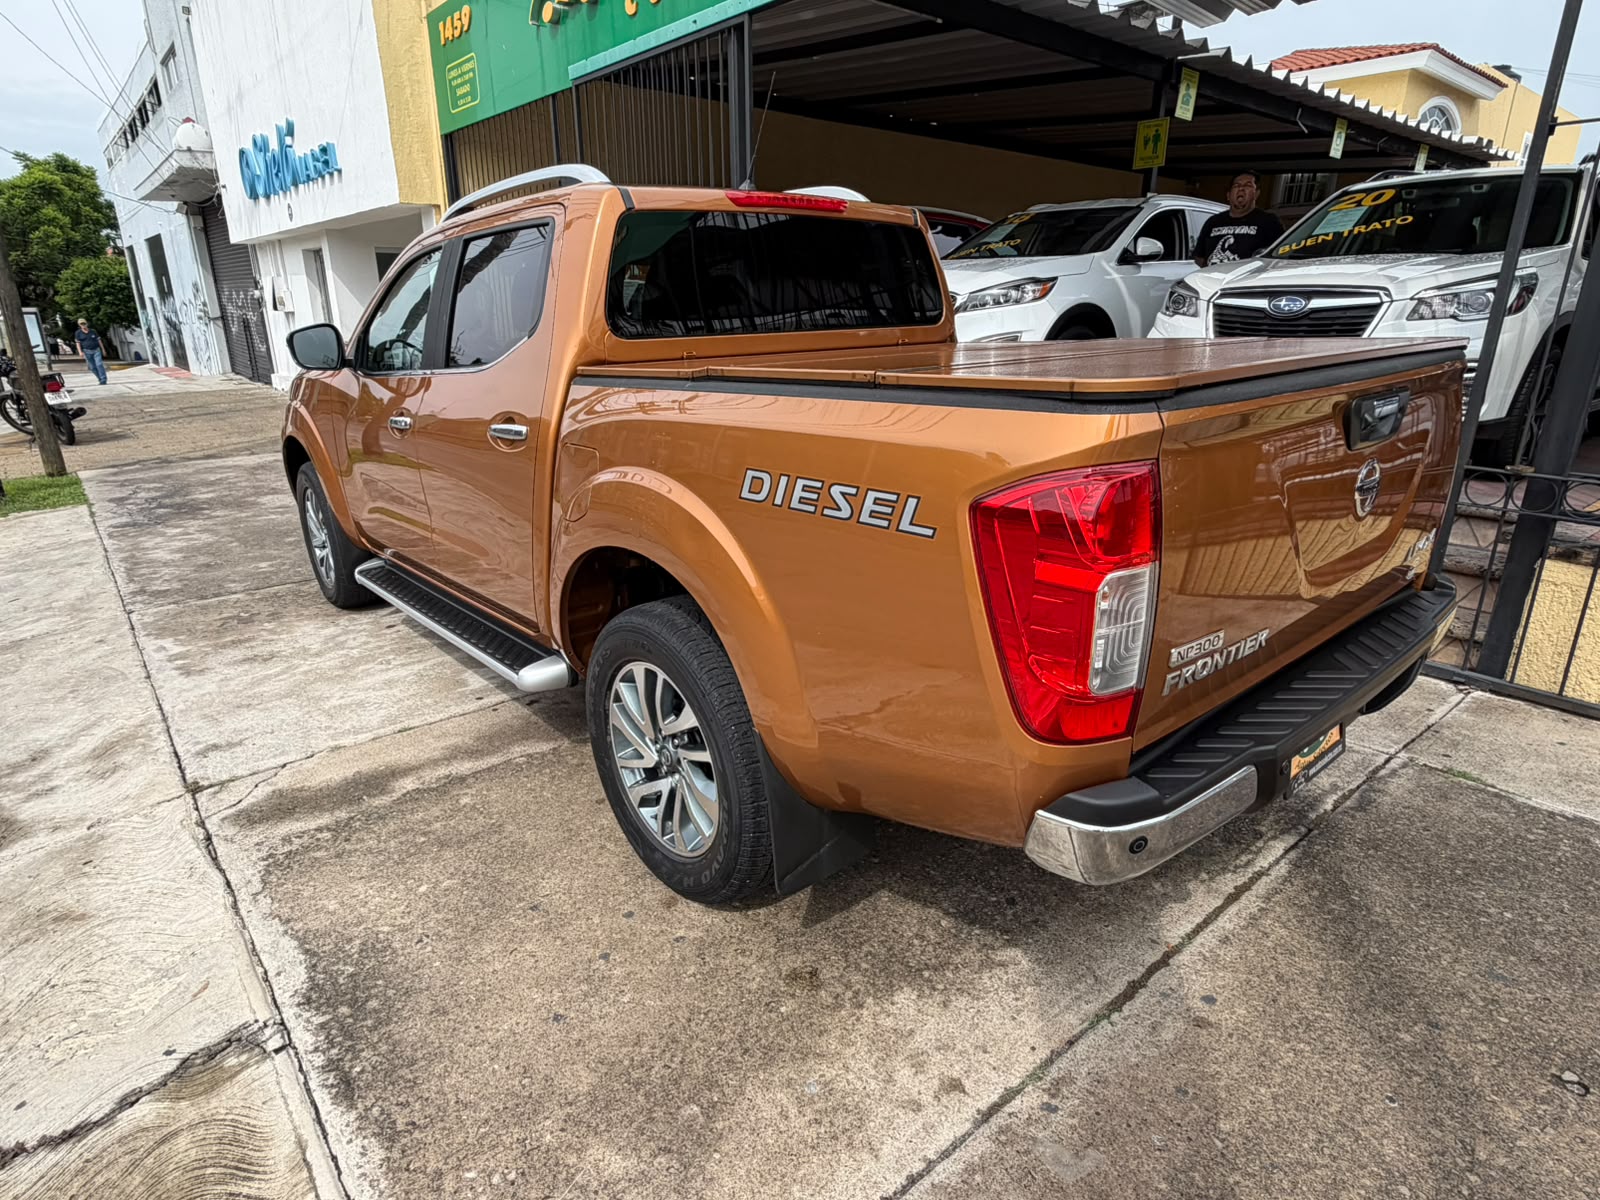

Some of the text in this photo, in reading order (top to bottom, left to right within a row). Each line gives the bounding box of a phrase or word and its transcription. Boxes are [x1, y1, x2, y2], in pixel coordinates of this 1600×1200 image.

[438, 4, 472, 46] 1459
[1327, 188, 1397, 212] 20
[980, 238, 1022, 251] TRATO
[1210, 225, 1258, 237] SCORPIONS
[1278, 232, 1333, 256] BUEN
[1343, 215, 1414, 237] TRATO
[739, 467, 938, 539] DIESEL
[1161, 628, 1270, 697] FRONTIER
[1175, 634, 1222, 662] NP300
